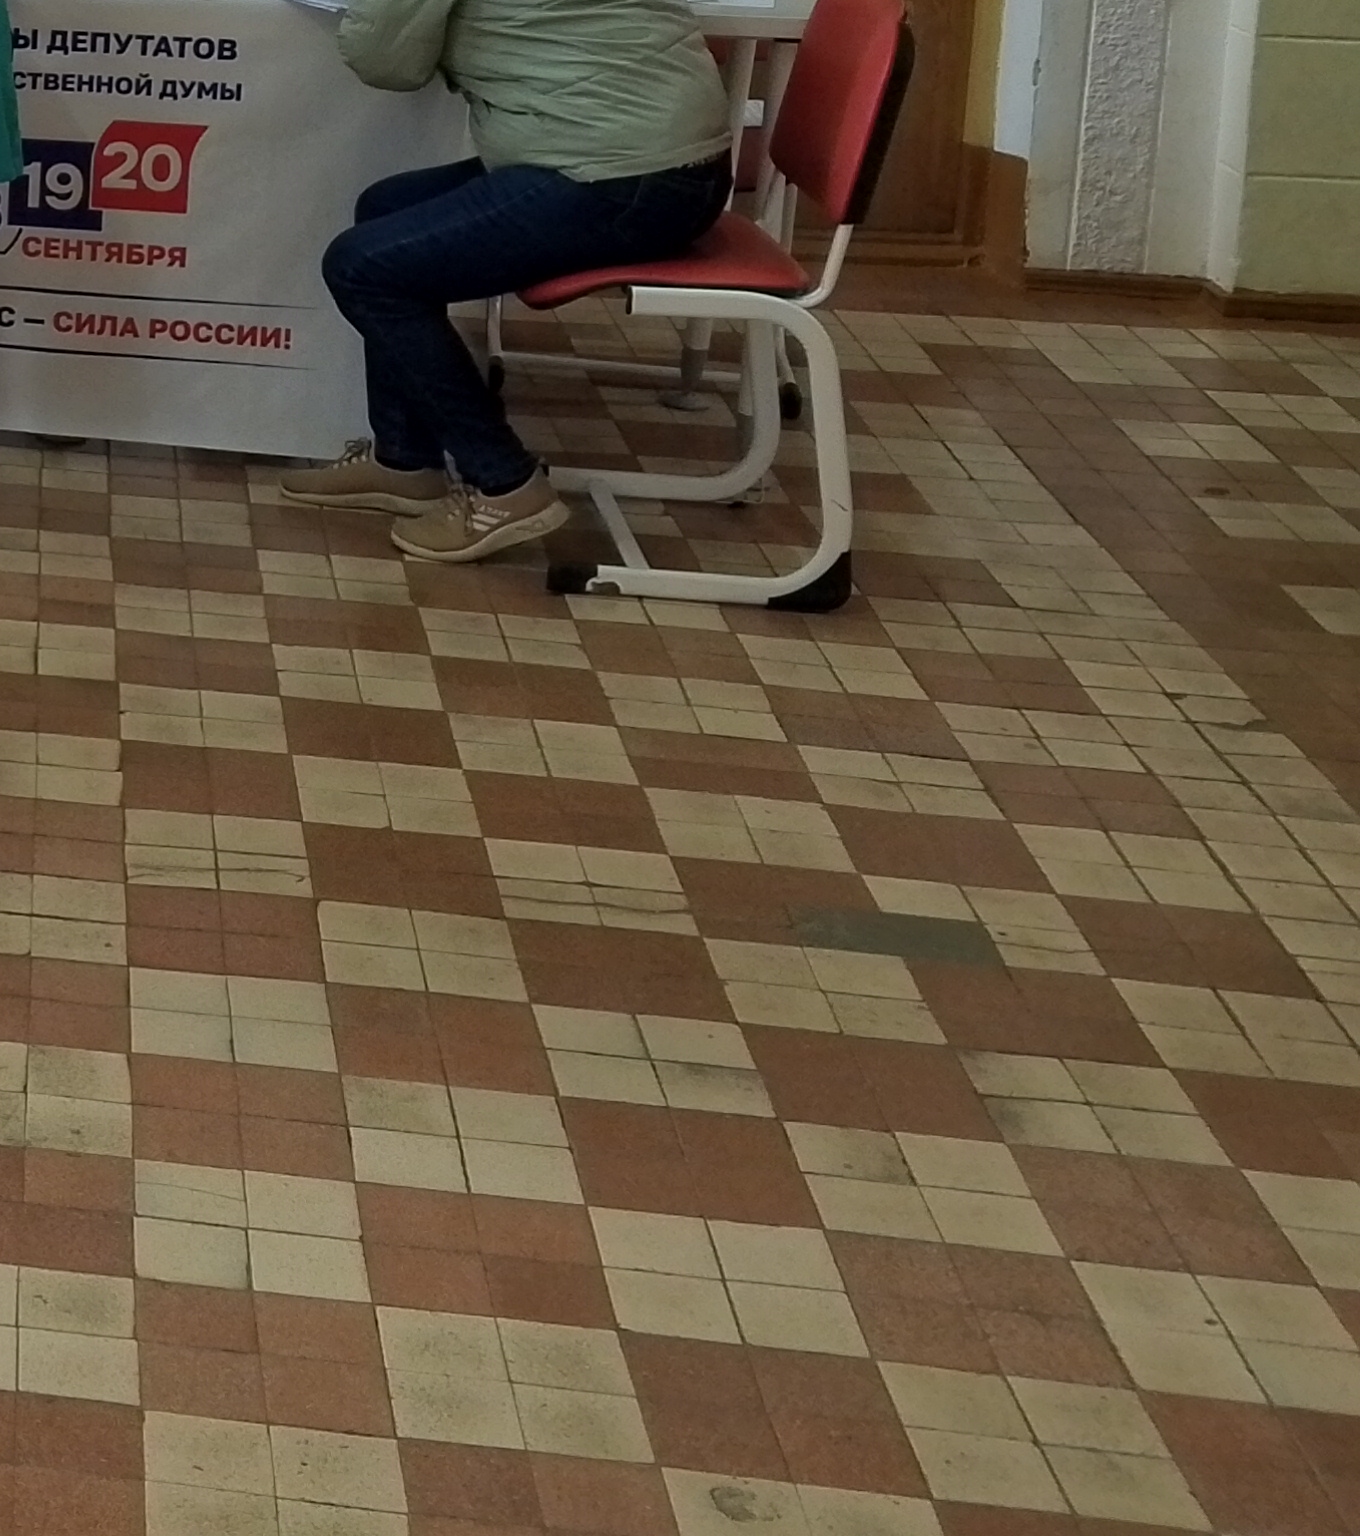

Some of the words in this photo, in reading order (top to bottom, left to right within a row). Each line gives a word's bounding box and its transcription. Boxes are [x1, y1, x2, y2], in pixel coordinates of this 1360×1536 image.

[46, 29, 238, 61] ДЕПУТАТОВ
[158, 79, 243, 102] ДУМЫ
[22, 161, 84, 211] 19
[101, 141, 183, 192] 20
[21, 236, 187, 267] СЕНТЯБРЯ
[52, 311, 140, 339] СИЛА
[148, 317, 292, 351] РОССИИ!
